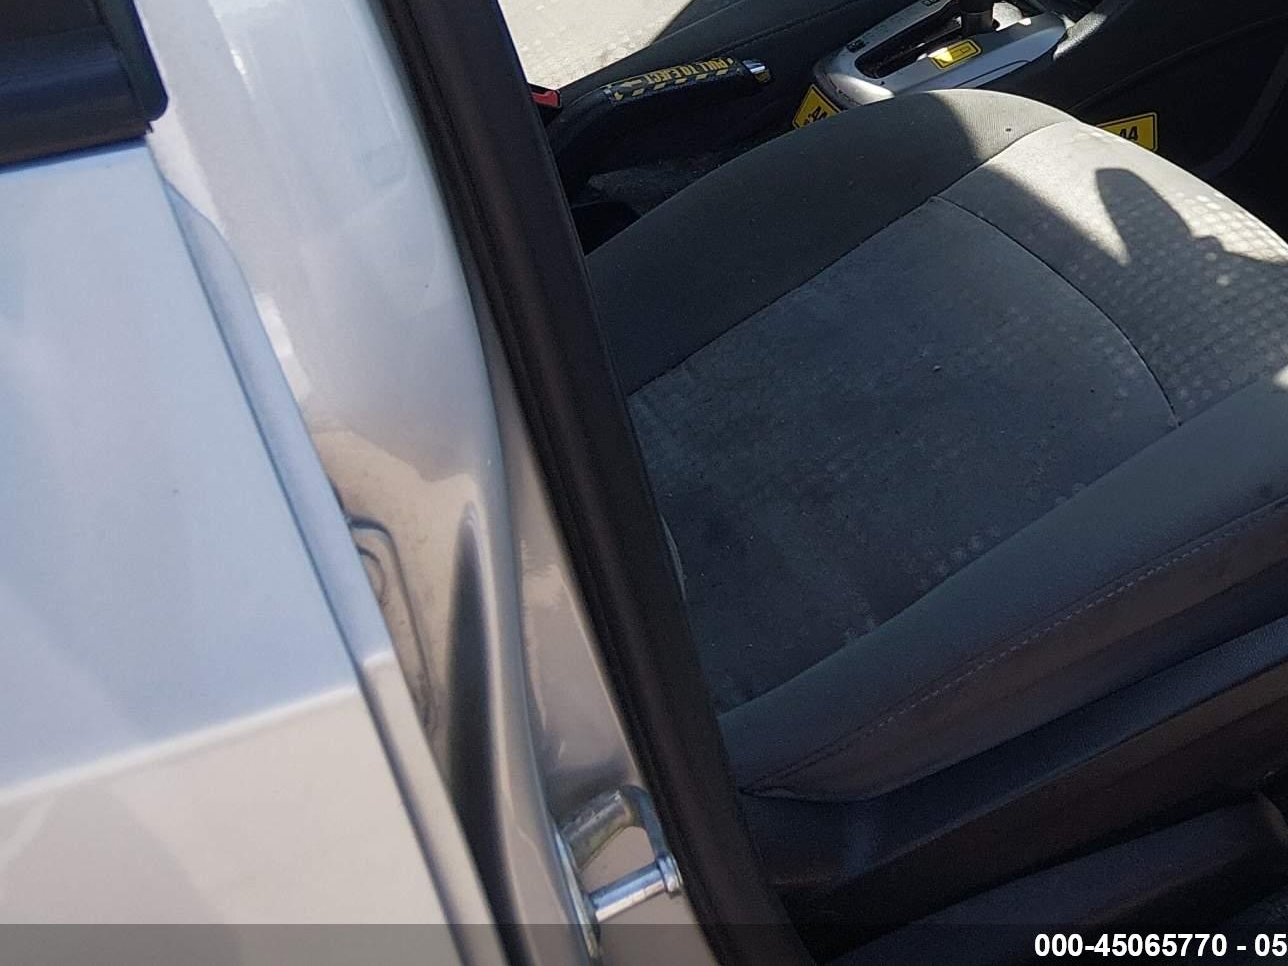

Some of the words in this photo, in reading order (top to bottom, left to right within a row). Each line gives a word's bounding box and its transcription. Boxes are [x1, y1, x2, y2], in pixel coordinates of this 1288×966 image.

[681, 64, 699, 77] TO
[703, 58, 729, 72] PULL
[645, 68, 682, 84] EJECT
